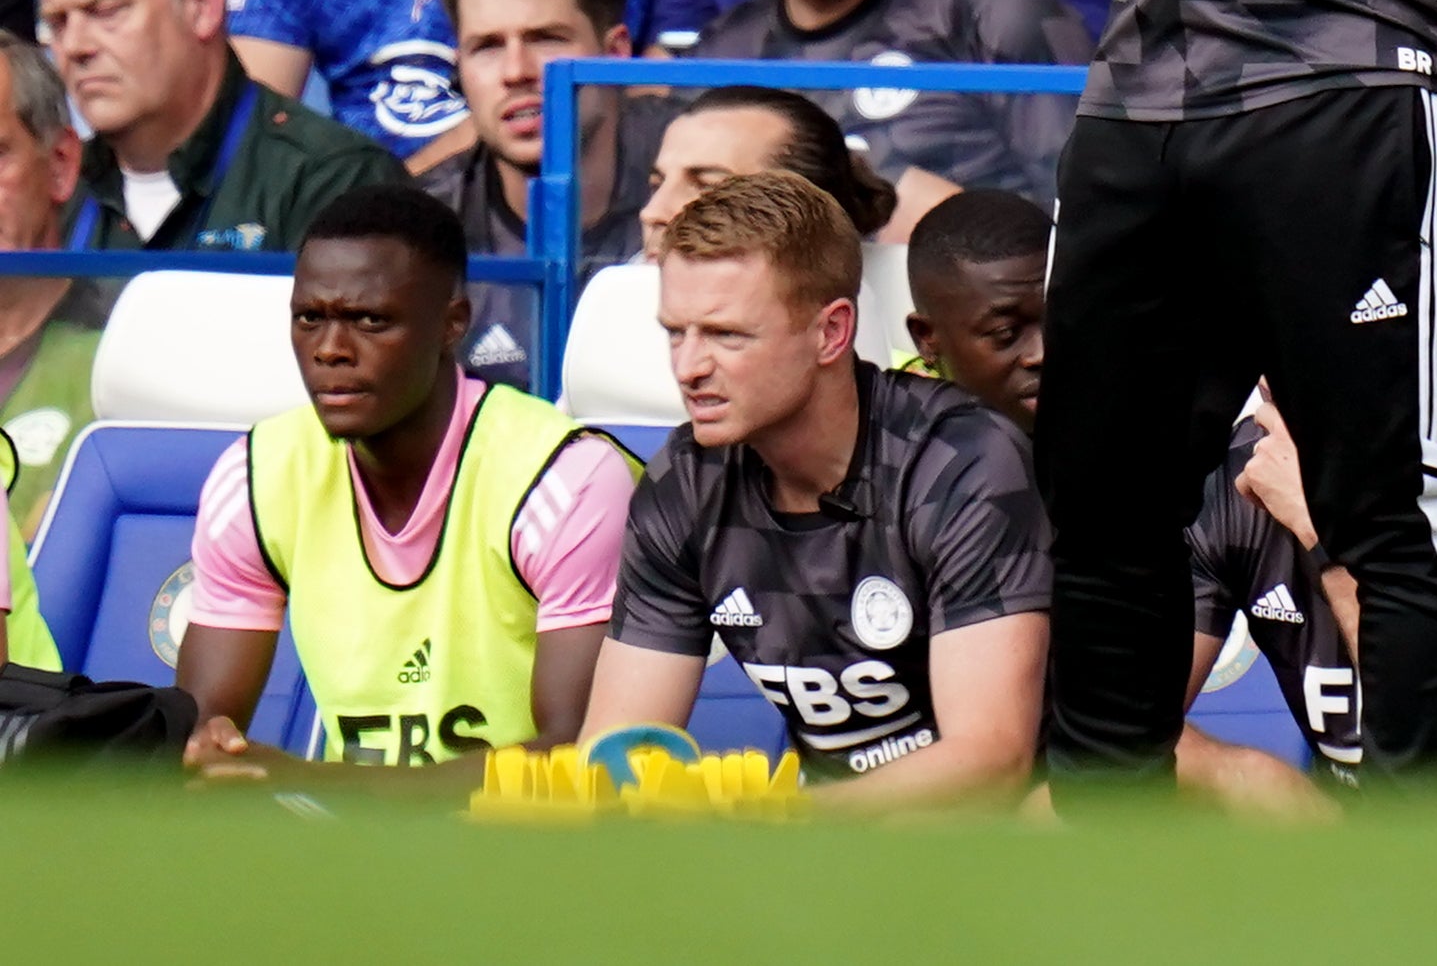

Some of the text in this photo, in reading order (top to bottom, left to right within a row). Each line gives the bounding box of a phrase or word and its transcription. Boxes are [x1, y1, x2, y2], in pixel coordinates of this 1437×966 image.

[1397, 47, 1433, 76] BR
[1350, 302, 1408, 324] adidas
[709, 612, 763, 627] adidas
[1250, 604, 1305, 624] adidas
[742, 659, 911, 727] FBS
[337, 704, 494, 767] FBS
[849, 728, 934, 774] online
